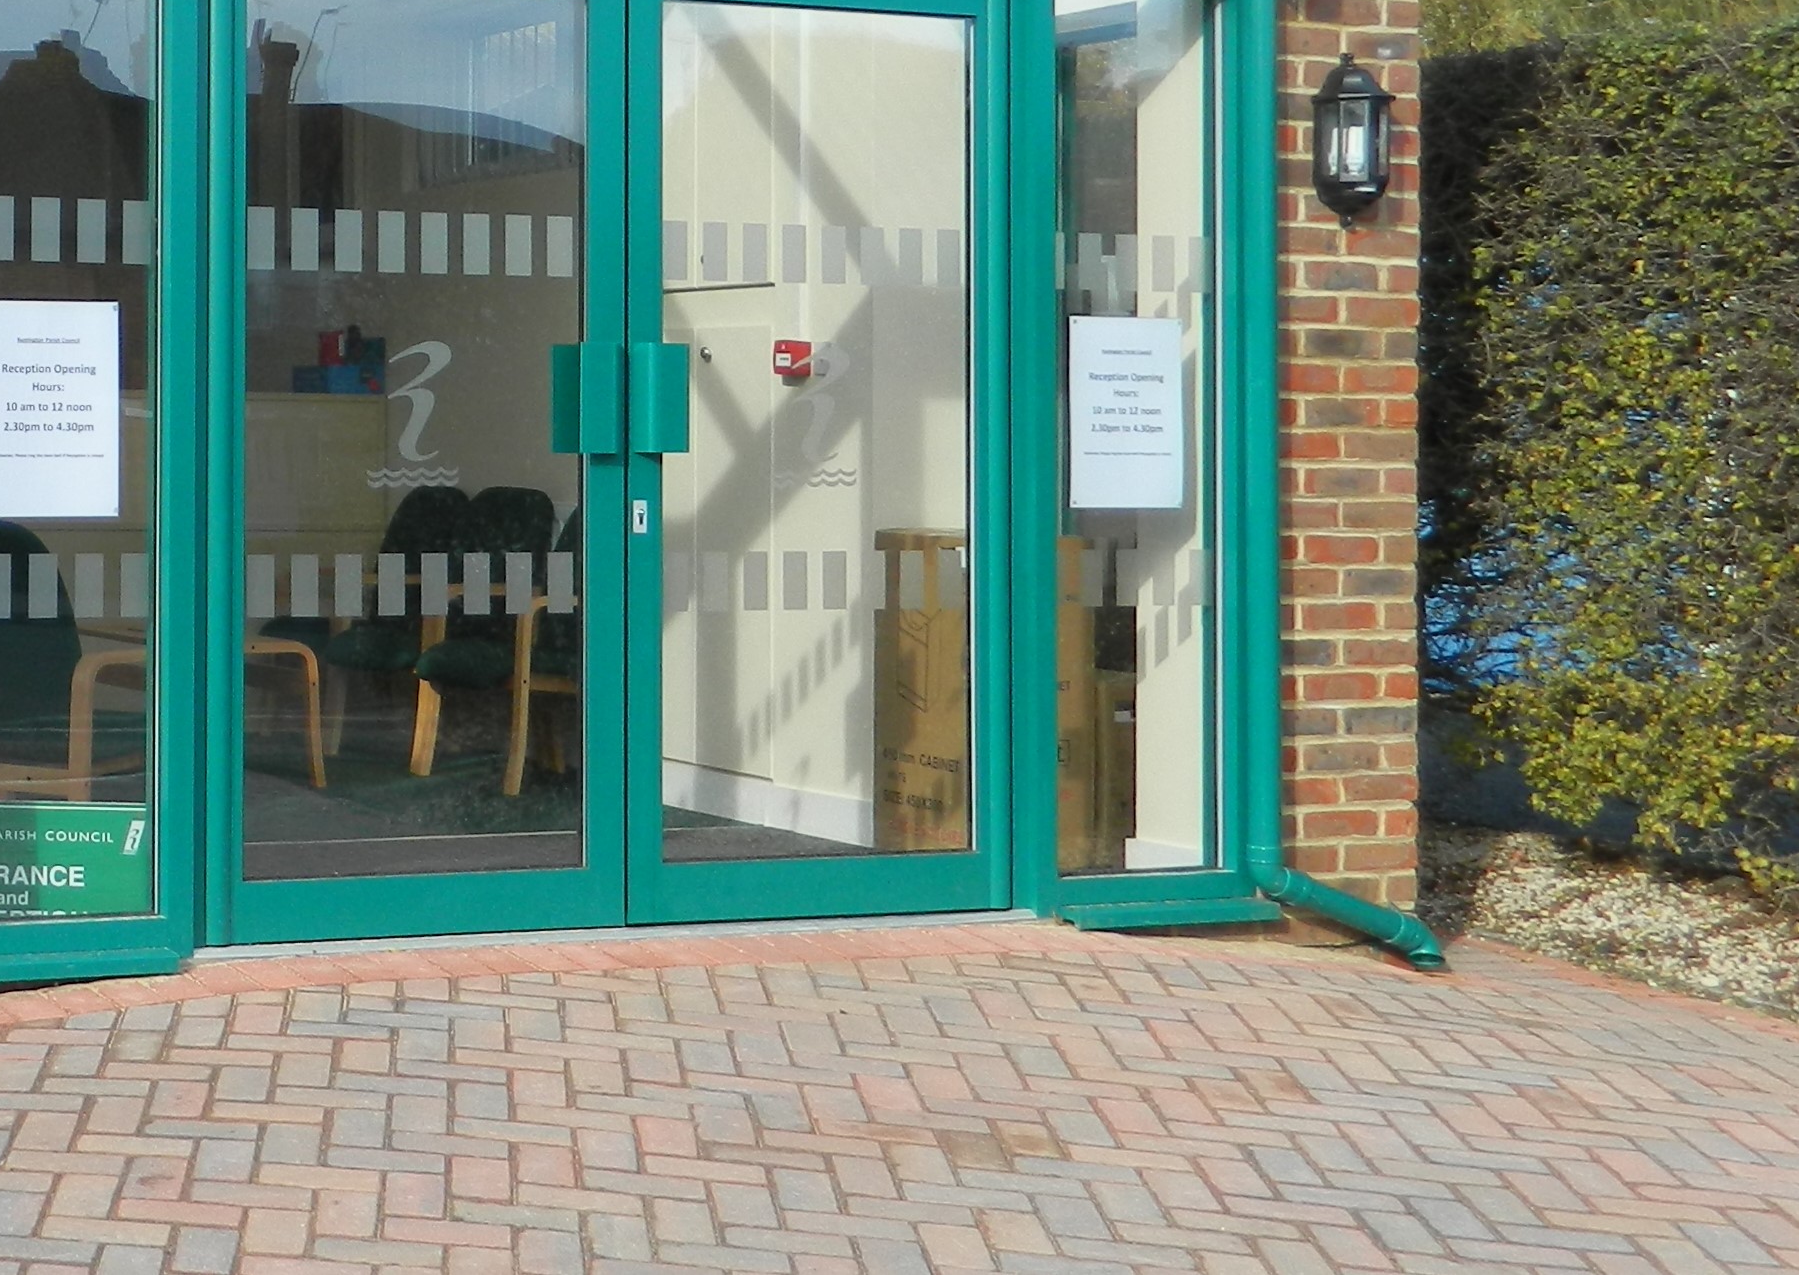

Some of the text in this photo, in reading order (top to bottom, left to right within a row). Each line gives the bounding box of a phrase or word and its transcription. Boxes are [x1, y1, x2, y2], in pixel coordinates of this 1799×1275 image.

[2, 363, 96, 376] Reception Opening
[1089, 372, 1164, 384] Reception Opening
[32, 382, 65, 392] Hours:
[6, 402, 92, 412] 10 am to 12 noon
[1118, 407, 1127, 415] to
[3, 422, 94, 433] 2.30pm to 4.30pm
[919, 754, 960, 773] CABINET
[45, 830, 114, 843] COUNCIL
